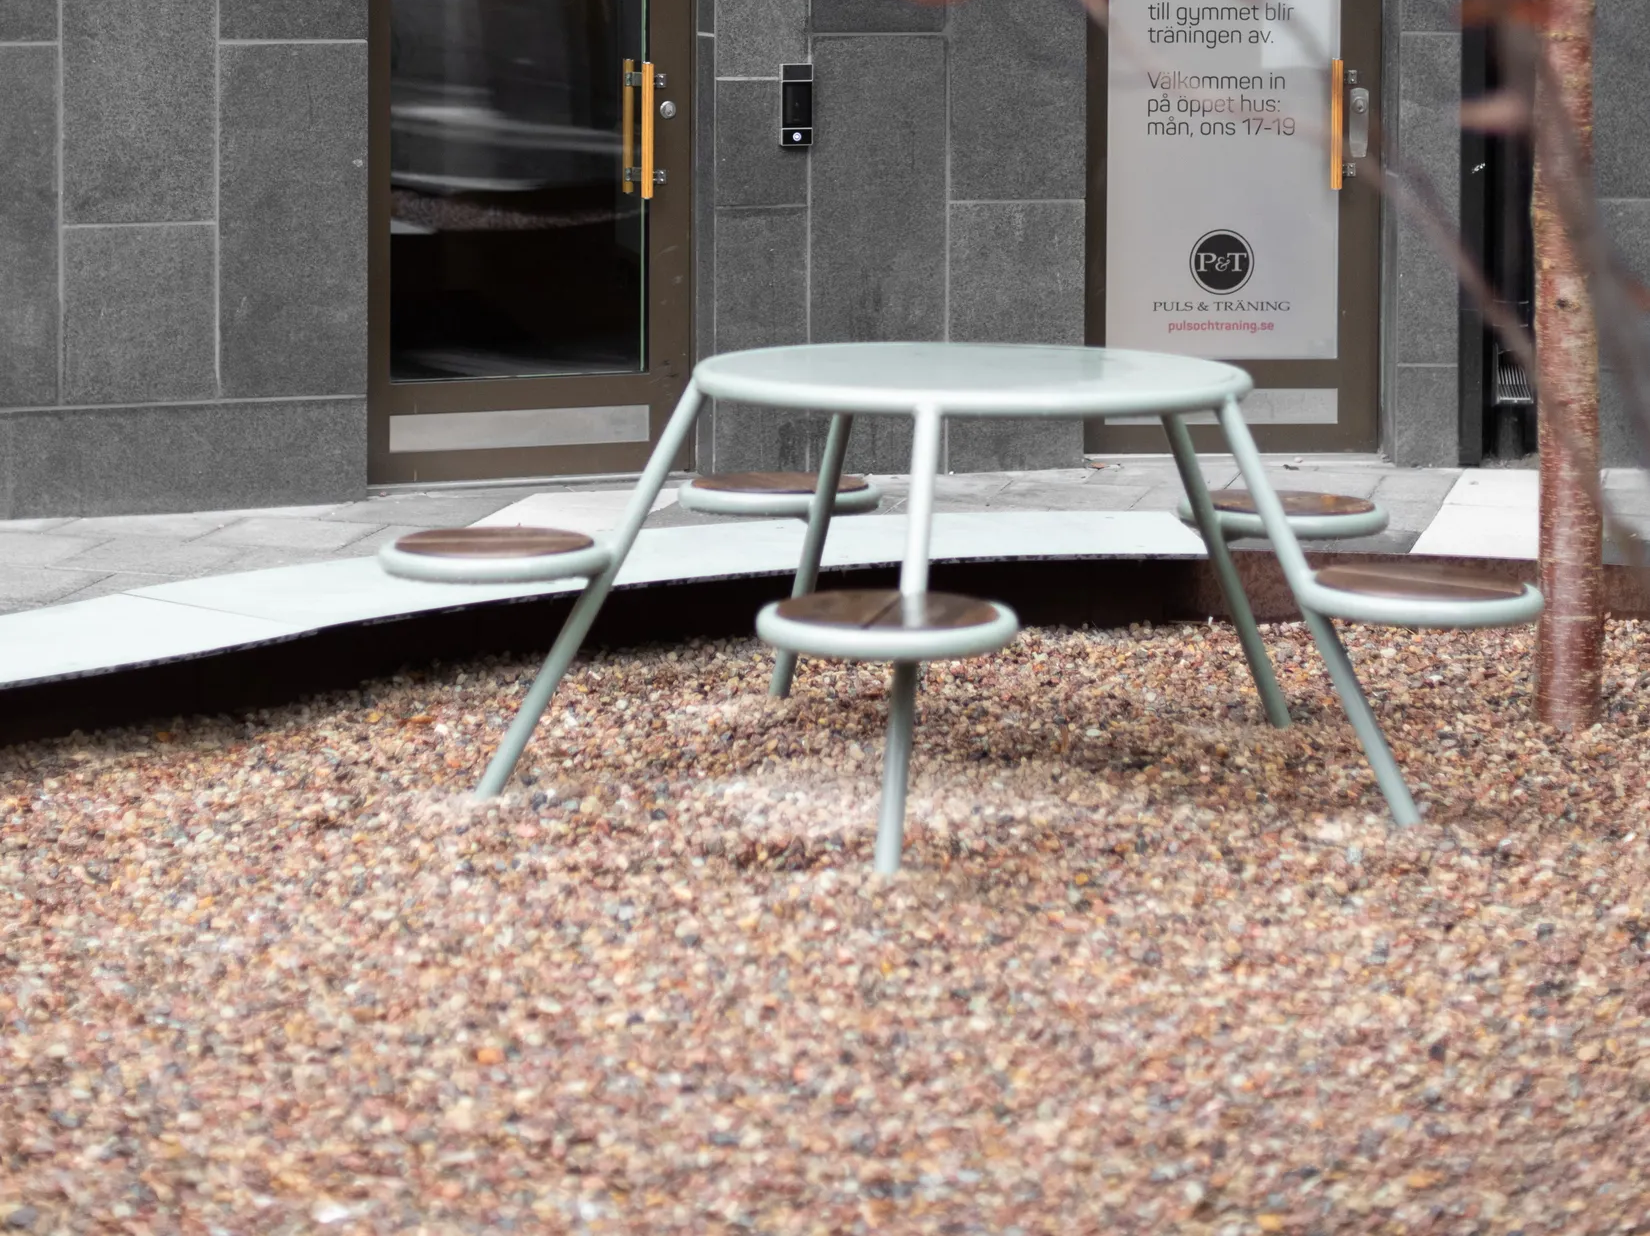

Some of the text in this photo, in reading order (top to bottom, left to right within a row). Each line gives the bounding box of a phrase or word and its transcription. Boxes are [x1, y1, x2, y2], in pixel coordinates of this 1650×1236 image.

[1148, 2, 1294, 26] till gymmet blir
[1148, 25, 1274, 49] träningen av.
[1147, 71, 1286, 90] Välkommen in
[1147, 93, 1281, 116] på öppet hus:
[1147, 117, 1295, 138] mån, ons 17-19
[1196, 252, 1247, 272] P&T
[1153, 299, 1291, 312] PULS & TRÄNING
[1168, 320, 1274, 333] pulsochtraning.se
